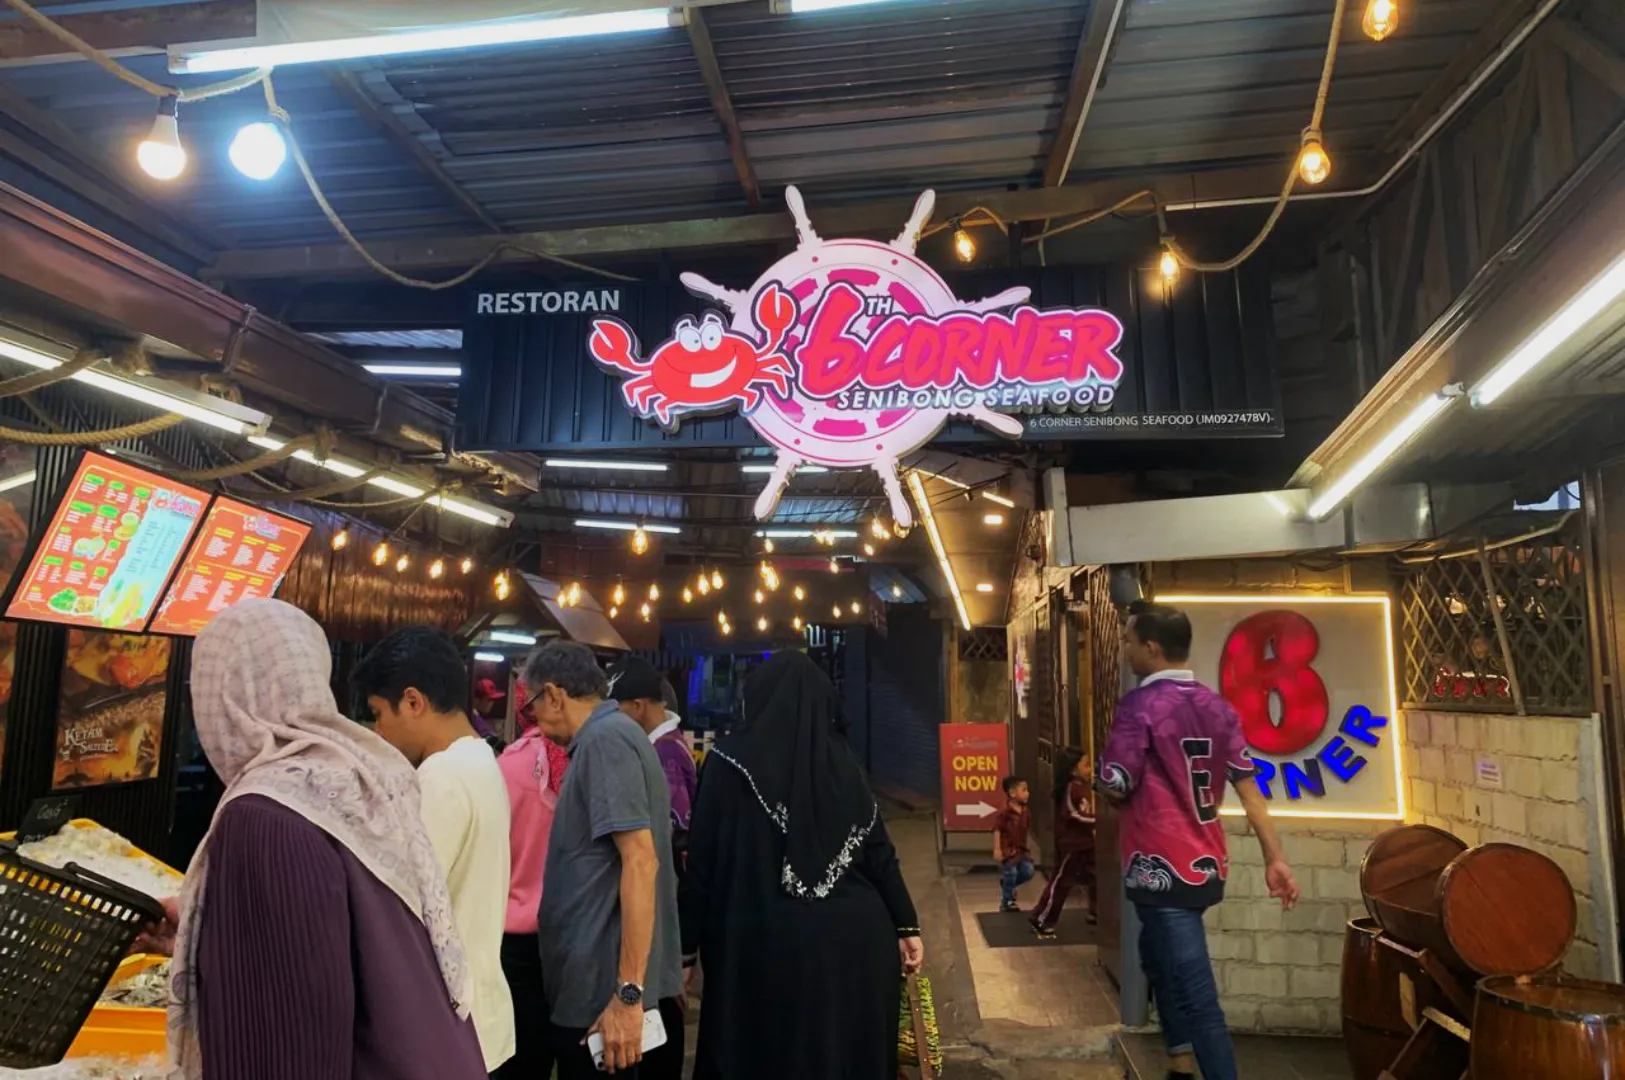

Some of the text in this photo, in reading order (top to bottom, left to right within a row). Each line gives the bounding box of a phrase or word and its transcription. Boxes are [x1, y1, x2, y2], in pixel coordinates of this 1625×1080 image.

[477, 290, 620, 313] RESTORAN
[799, 283, 1123, 397] 6 TH CORNER
[837, 385, 1116, 410] SENIBONG SEAFOOD
[1029, 418, 1037, 428] 6
[1039, 417, 1081, 428] CORNER
[1083, 416, 1139, 427] SENIBONG
[1142, 415, 1194, 425] SEAFOOD
[1219, 609, 1330, 756] 6
[952, 756, 999, 772] OPEN
[1251, 704, 1389, 801] RNER
[955, 775, 998, 791] NOW
